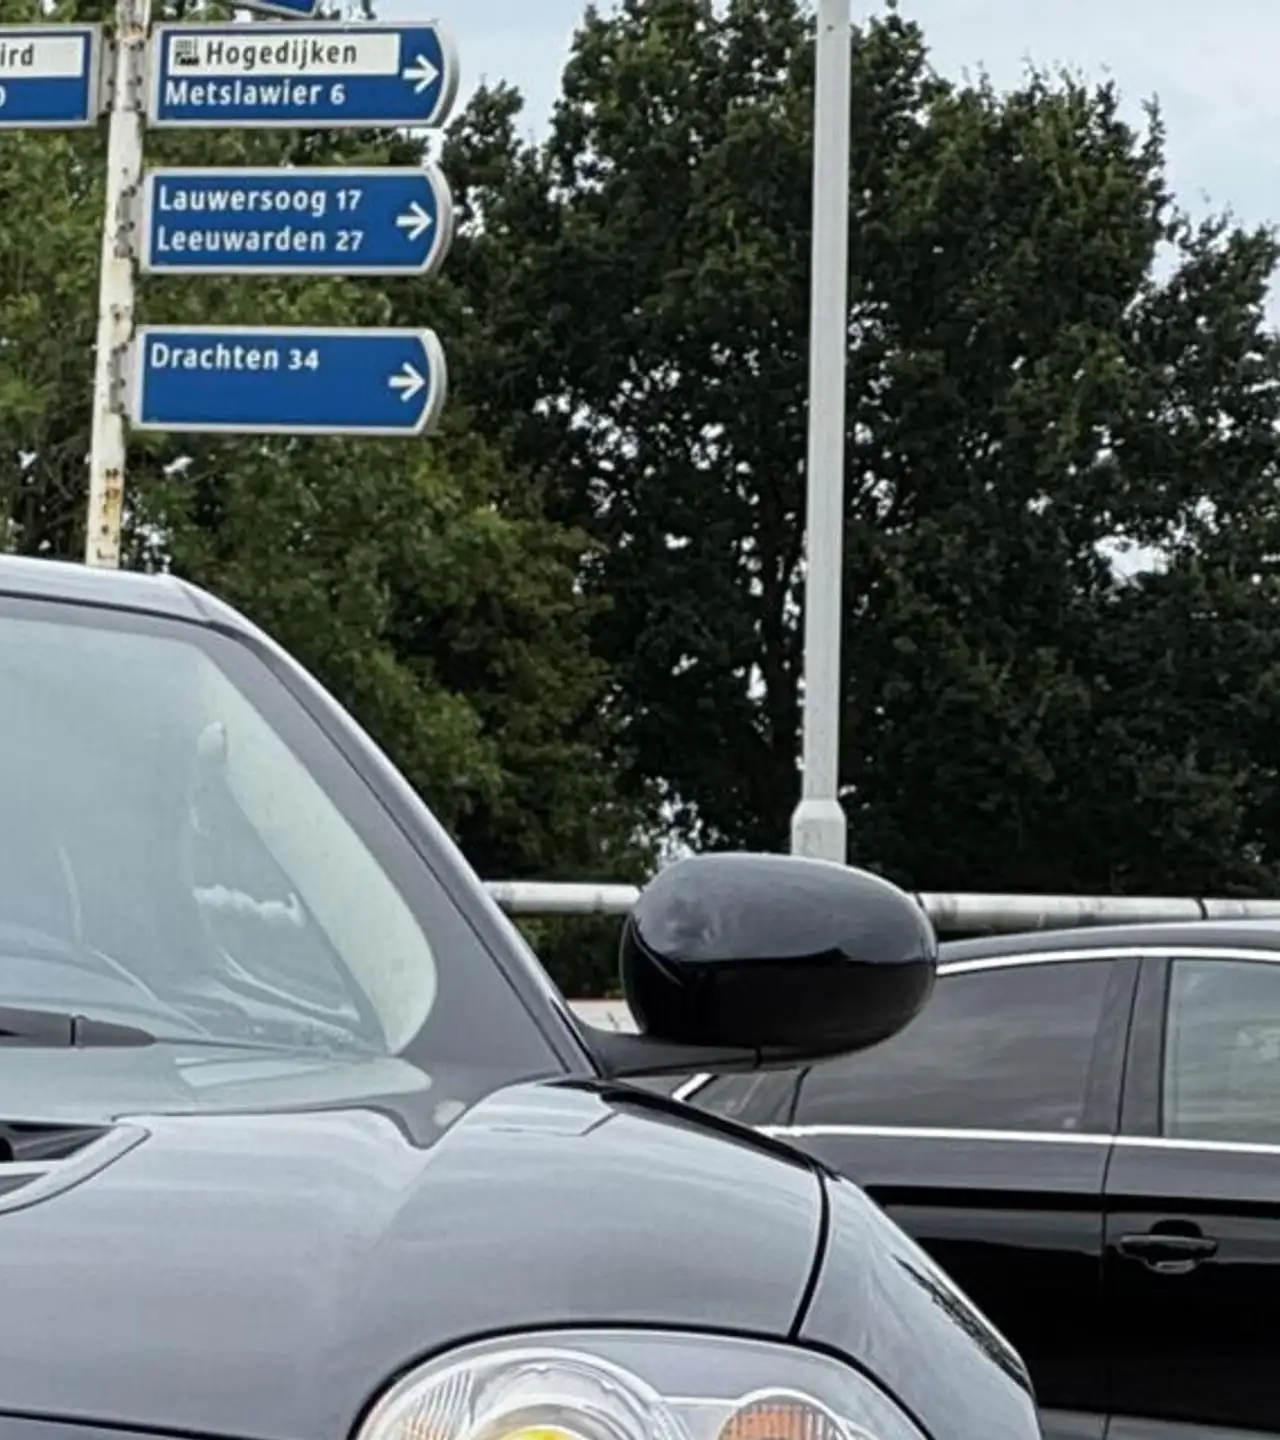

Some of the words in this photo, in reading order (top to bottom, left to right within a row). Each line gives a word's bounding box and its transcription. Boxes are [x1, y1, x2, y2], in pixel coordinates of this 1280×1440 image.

[206, 41, 357, 70] Hogedijken
[165, 79, 322, 106] Metslawier
[330, 83, 346, 105] 6
[159, 184, 327, 217] Lauwersoog
[336, 189, 362, 210] 17
[157, 225, 326, 251] Leeuwarden
[336, 230, 365, 251] 27
[150, 342, 279, 370] Drachten
[288, 349, 320, 370] 34
